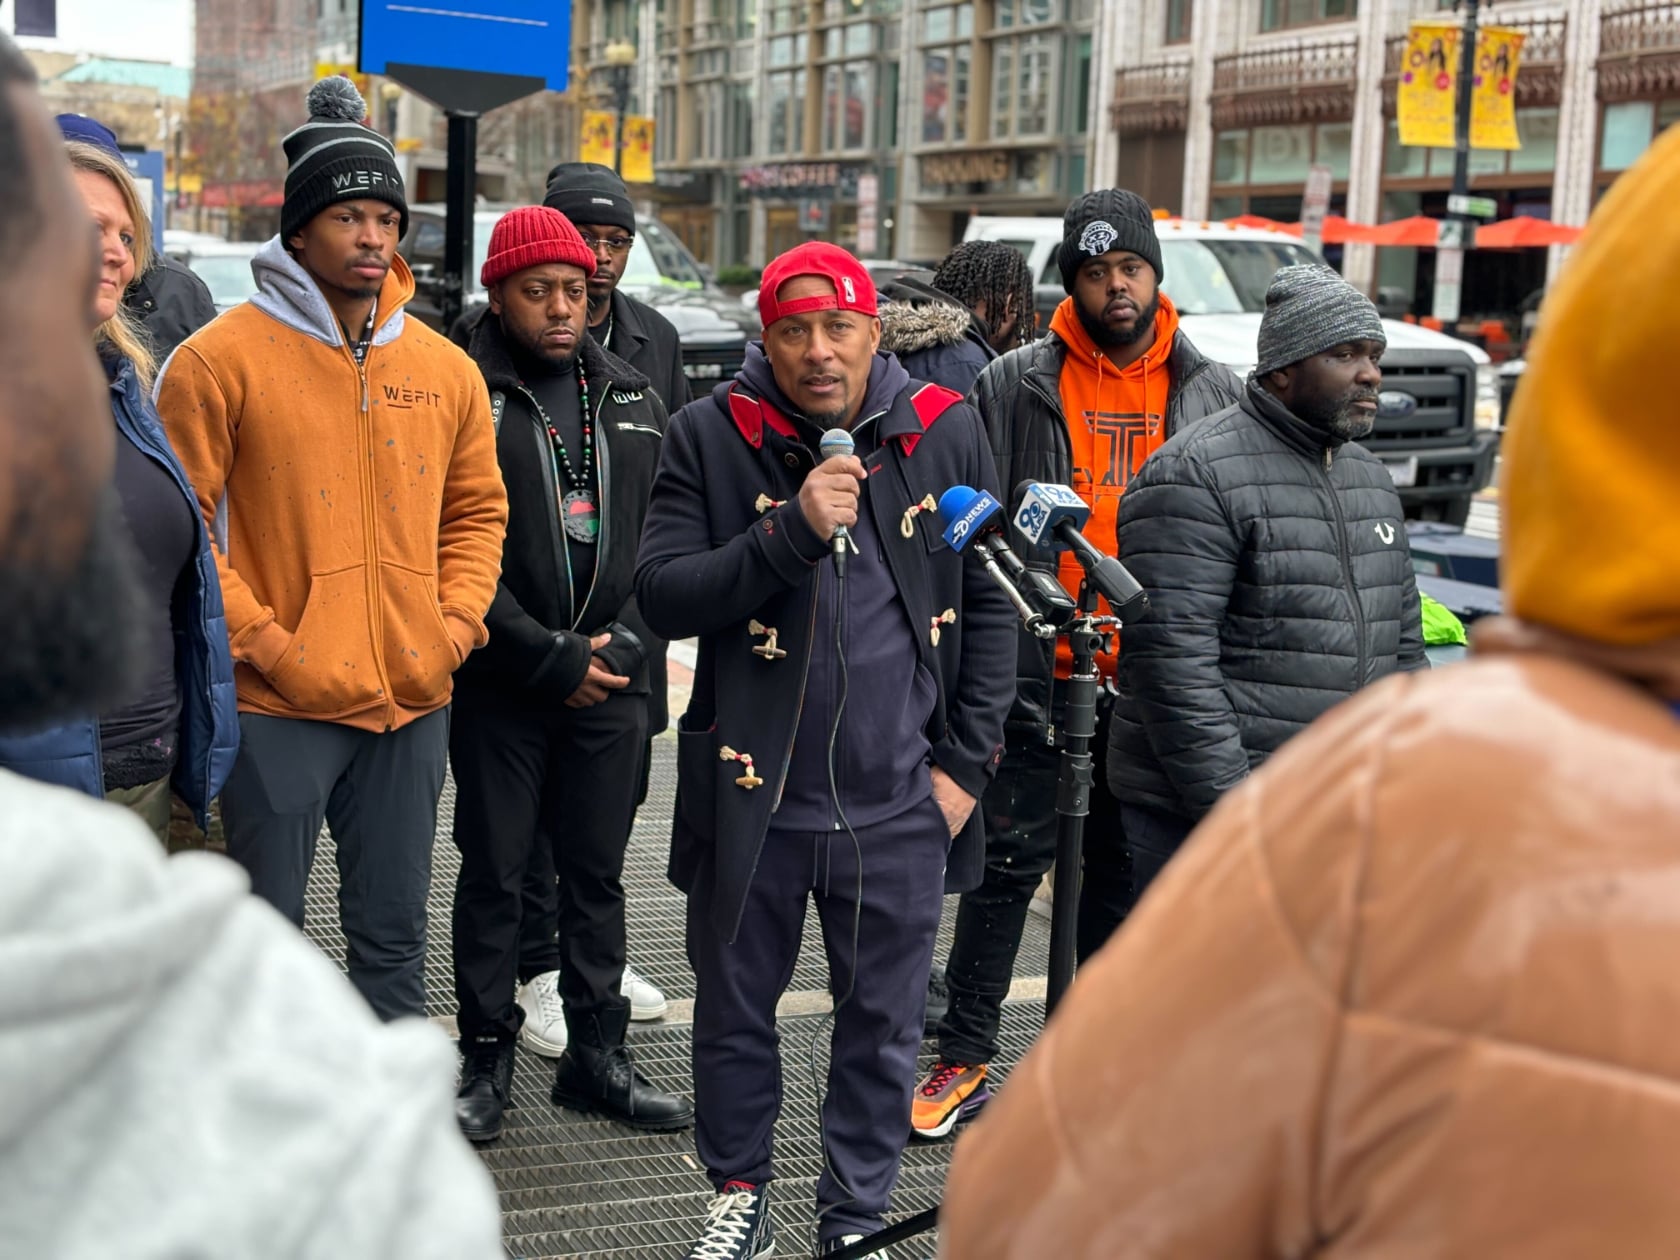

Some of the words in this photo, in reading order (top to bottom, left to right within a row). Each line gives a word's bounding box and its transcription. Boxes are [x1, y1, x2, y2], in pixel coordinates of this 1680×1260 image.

[383, 385, 441, 408] WEFIT
[965, 497, 991, 522] NEWS
[1030, 510, 1048, 538] WUSA
